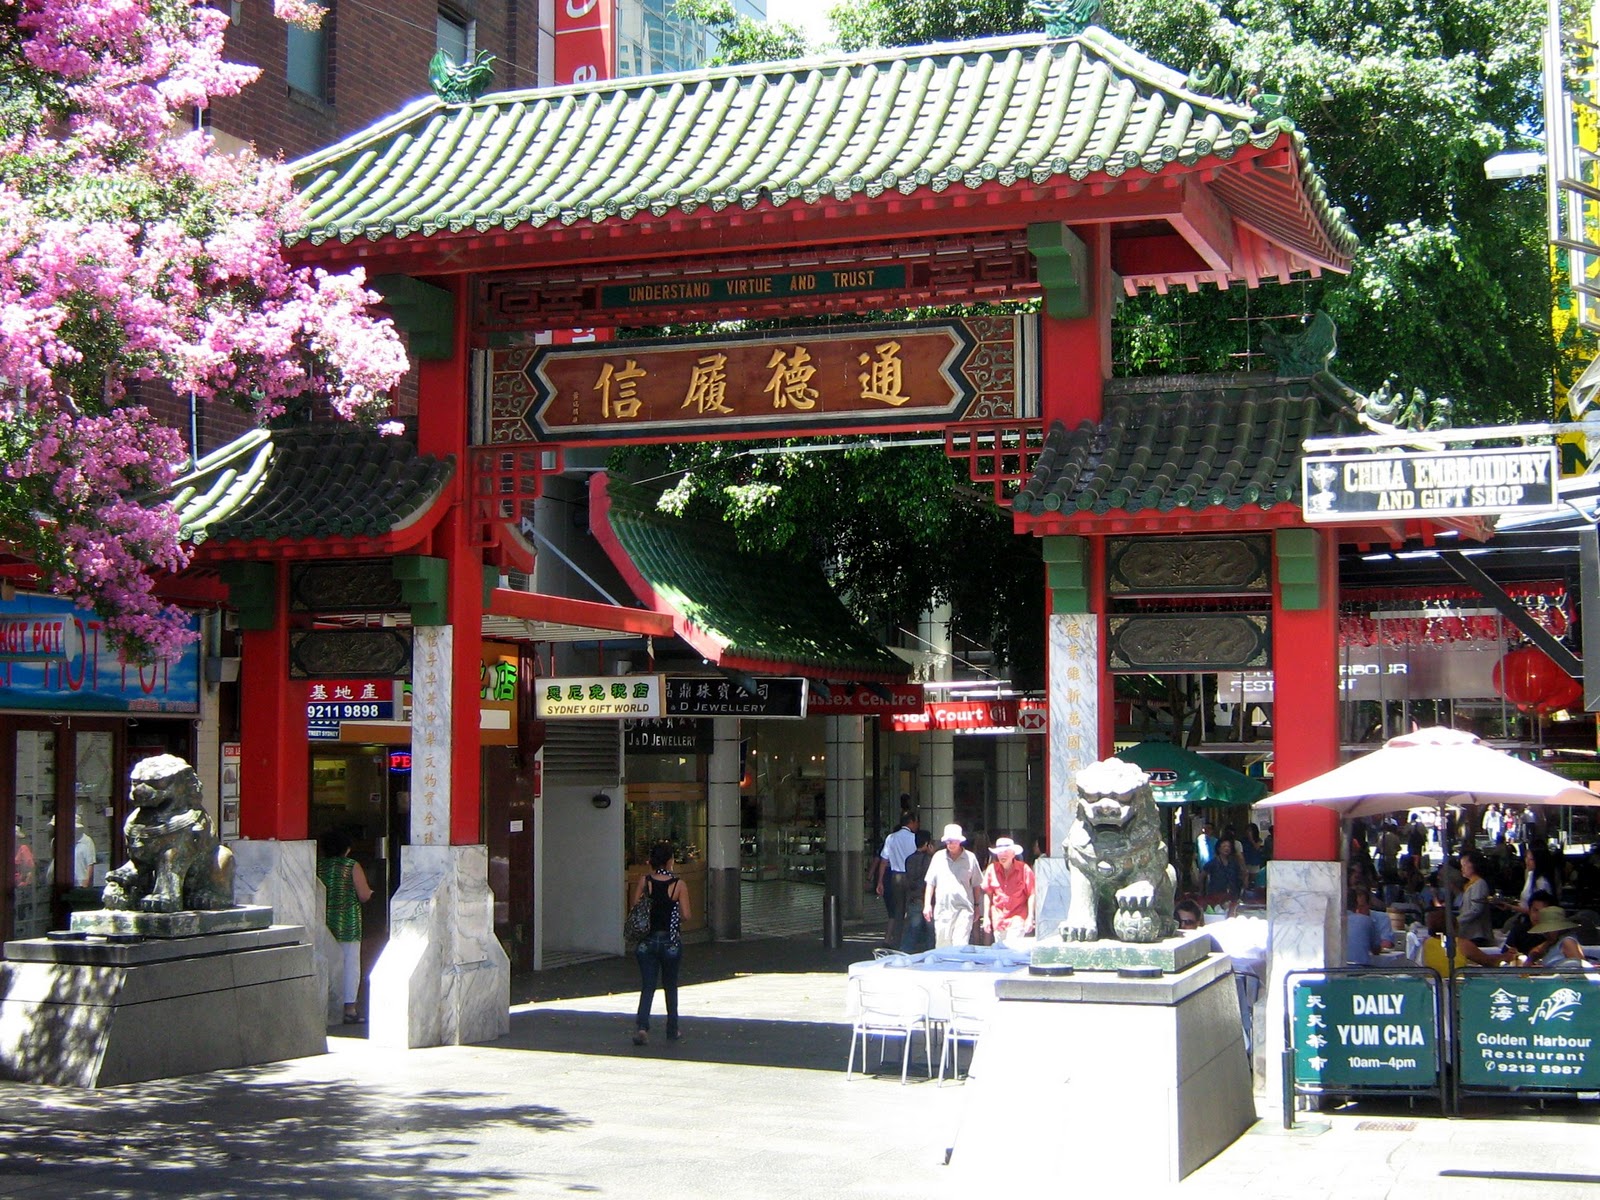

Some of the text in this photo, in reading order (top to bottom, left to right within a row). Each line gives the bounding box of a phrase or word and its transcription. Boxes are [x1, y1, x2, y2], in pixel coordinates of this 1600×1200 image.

[628, 270, 875, 302] UNDERSTAND VIRTUE AND TRUST
[1344, 454, 1550, 491] CHINA EMBROIDERY
[1377, 485, 1524, 510] AND GIFT SHOP
[33, 621, 63, 653] POT
[307, 704, 379, 718] 9211 9898
[547, 703, 650, 715] SYDNEY GIFT WORLD
[680, 702, 689, 711] D
[693, 703, 767, 712] JEWELLERY
[935, 707, 984, 722] Court
[642, 733, 648, 746] D
[651, 733, 697, 747] JEWELLERY
[1352, 994, 1404, 1015] DAILY
[1336, 1024, 1425, 1046] YUM CHA
[1476, 1032, 1592, 1048] Golden Harbour
[1481, 1048, 1585, 1061] Restaurant
[1497, 1063, 1582, 1074] 9212 5987
